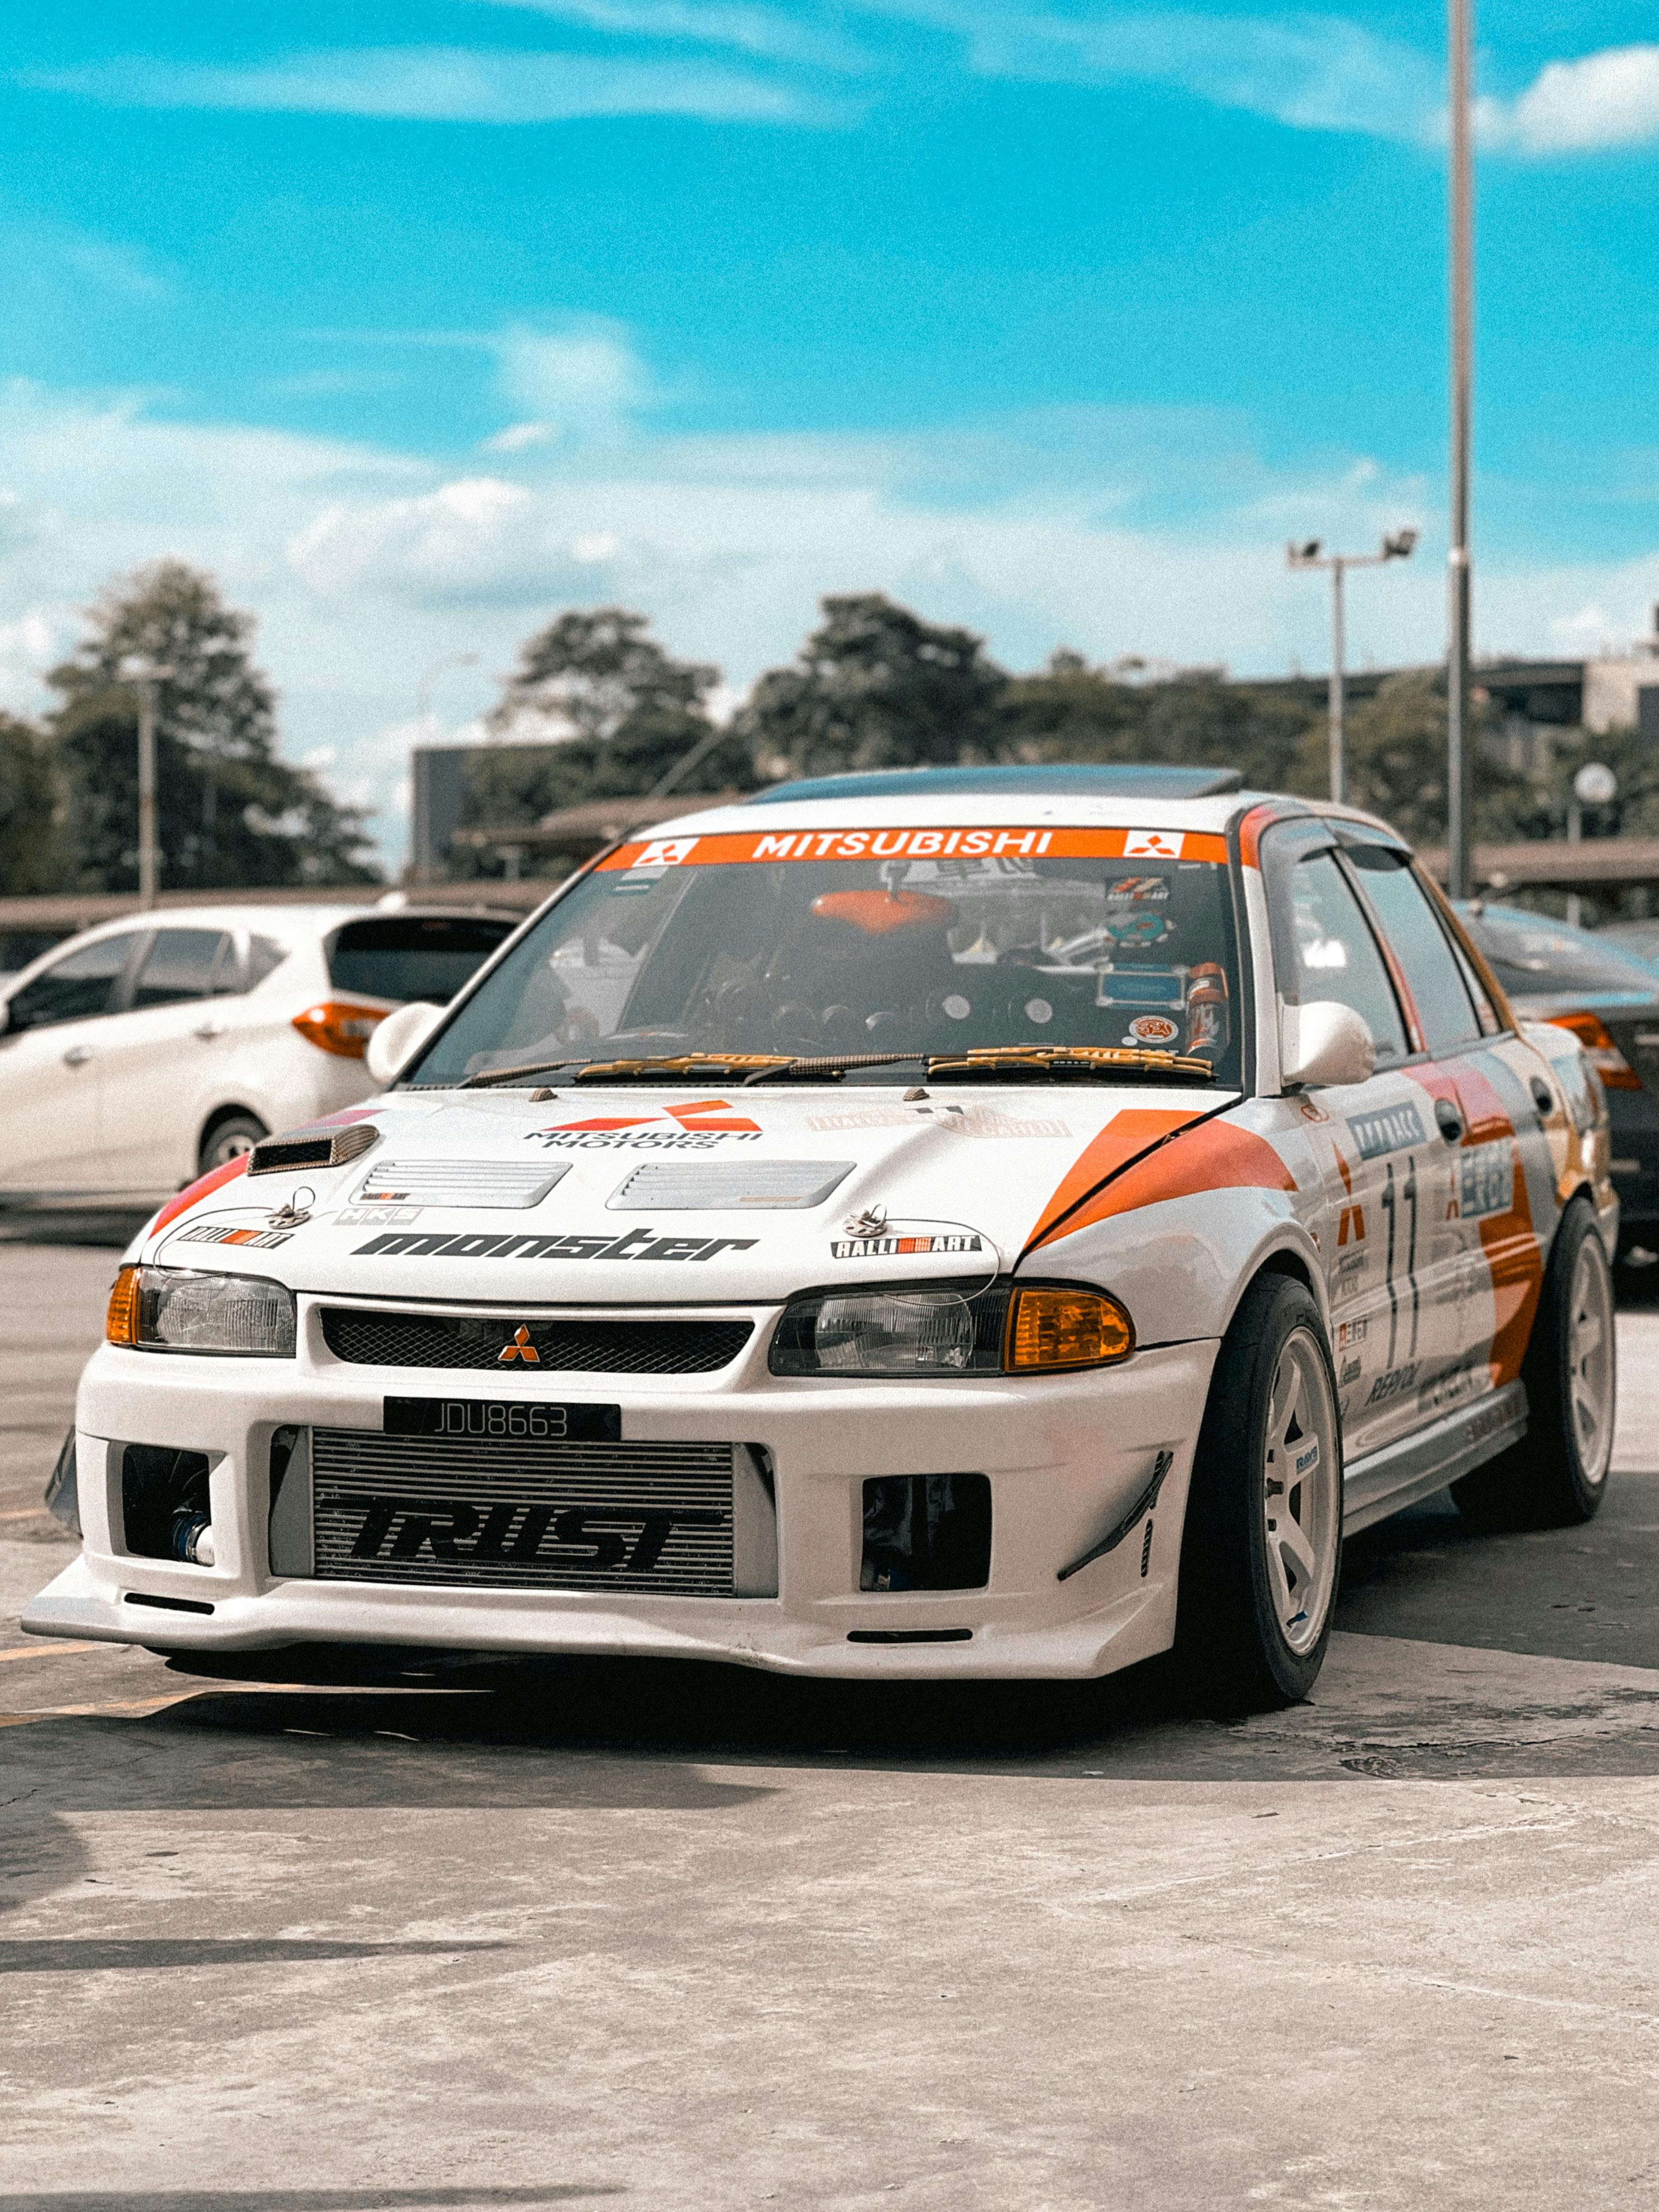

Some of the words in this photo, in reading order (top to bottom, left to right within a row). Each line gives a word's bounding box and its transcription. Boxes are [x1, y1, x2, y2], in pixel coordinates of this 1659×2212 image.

[753, 831, 1052, 858] MITSUBISHI
[524, 1131, 762, 1141] MITSUBISHI
[542, 1140, 717, 1149] MOTORS
[335, 1207, 424, 1225] HKS
[836, 1240, 897, 1257] RALLI
[932, 1235, 976, 1252] ART
[434, 1403, 567, 1436] JDU8663
[1296, 1446, 1318, 1470] RAYS
